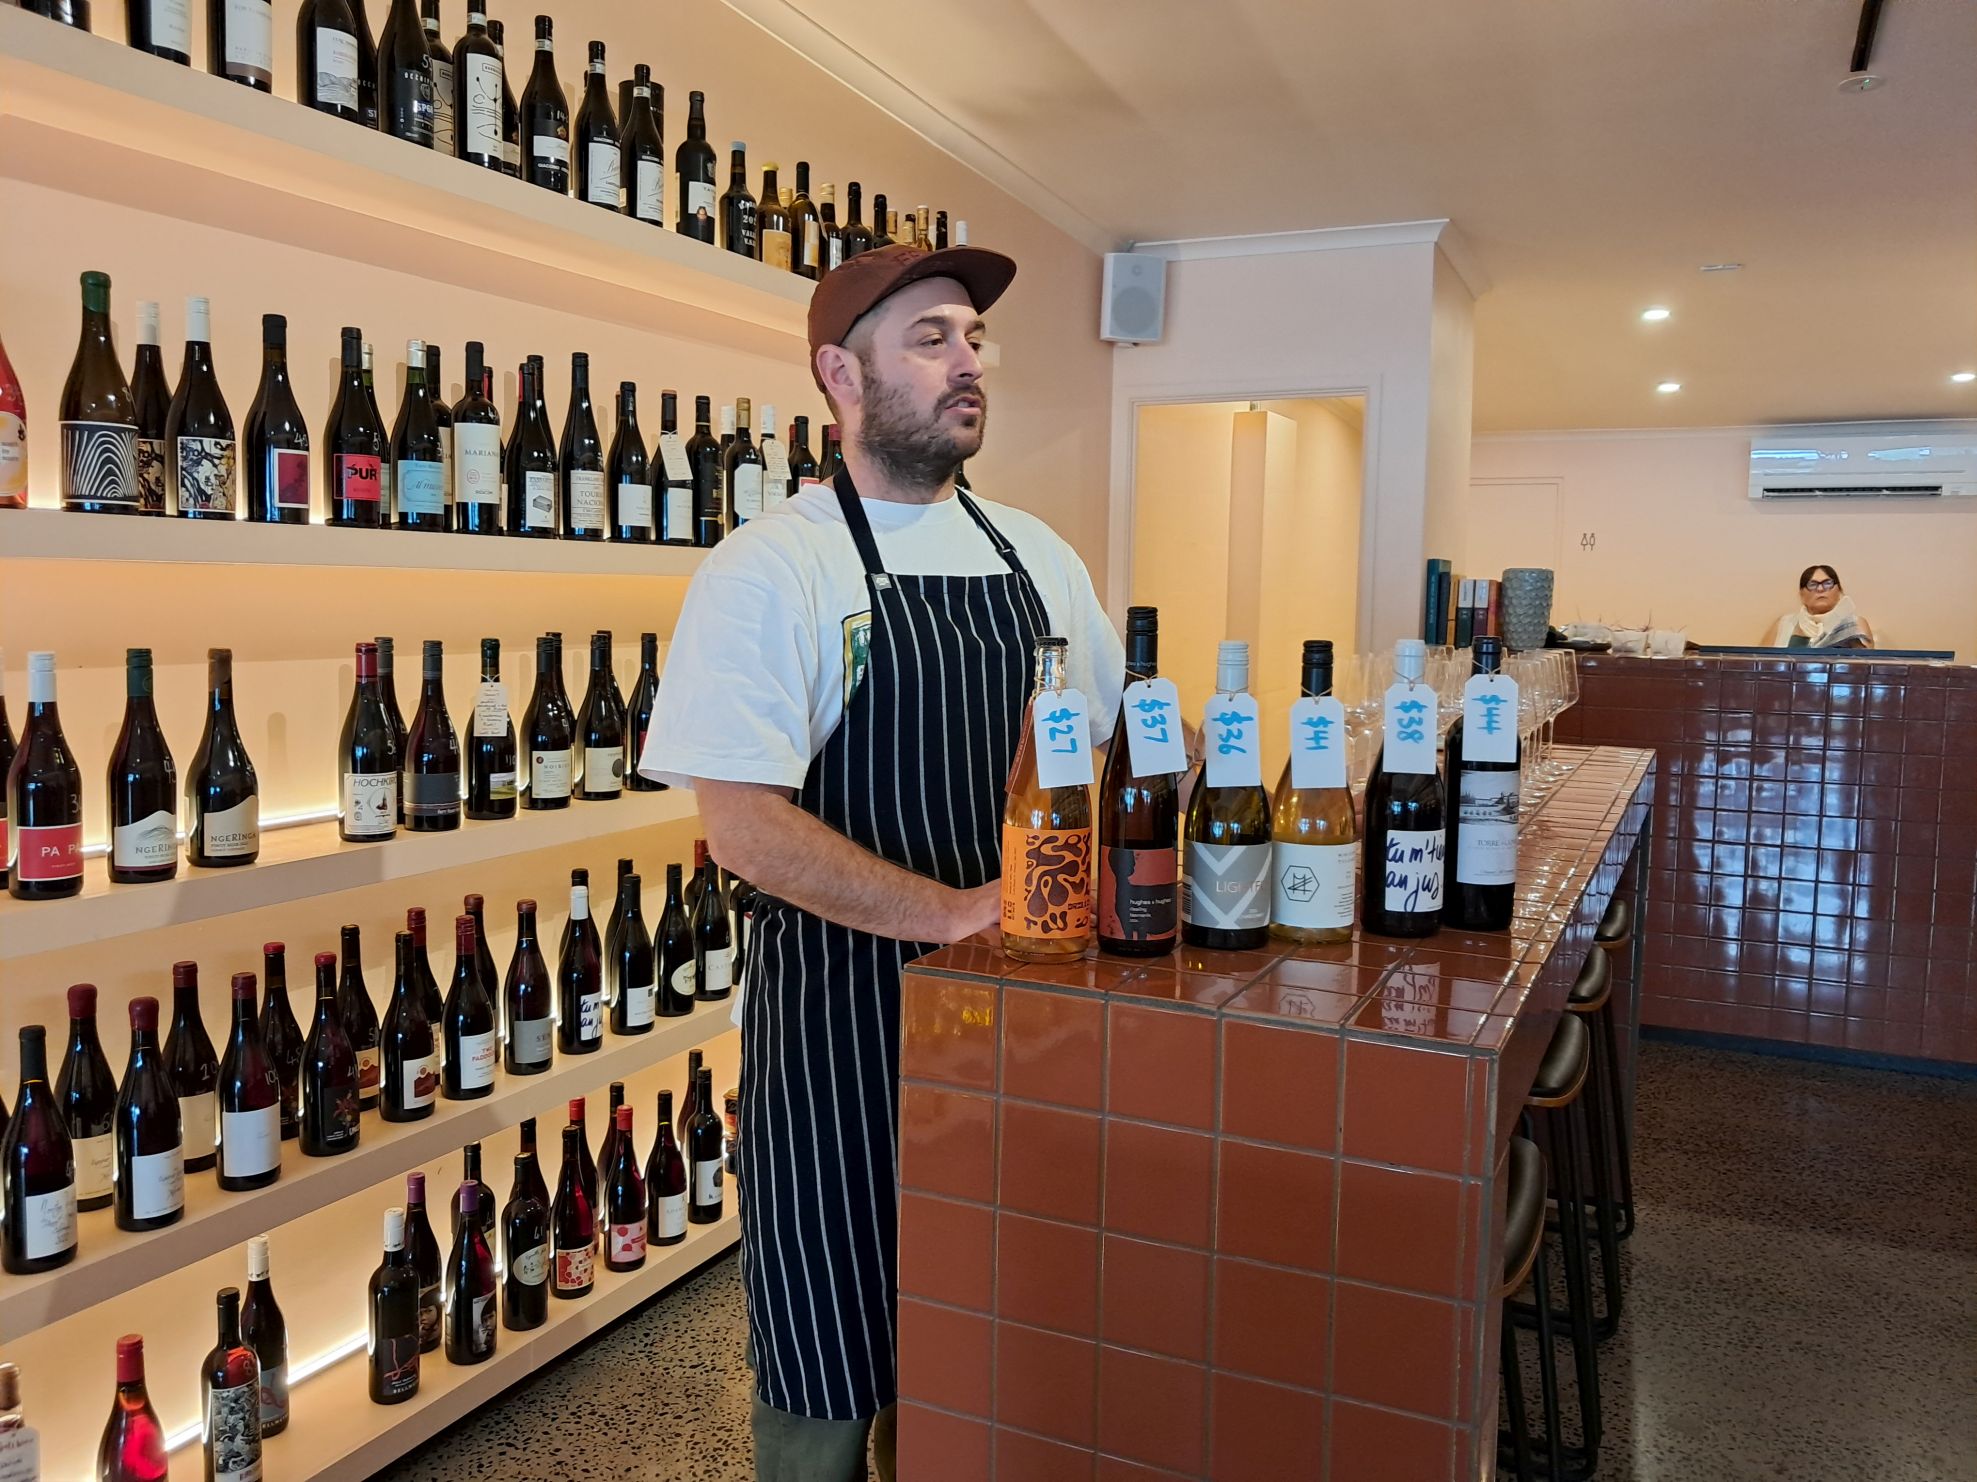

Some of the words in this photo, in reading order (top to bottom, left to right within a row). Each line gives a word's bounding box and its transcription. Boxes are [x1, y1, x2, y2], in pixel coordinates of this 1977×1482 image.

[1042, 708, 1080, 753] $27
[1131, 699, 1171, 743] $37
[1212, 711, 1254, 756] $36
[1395, 700, 1427, 744] $38
[1473, 695, 1507, 735] $44
